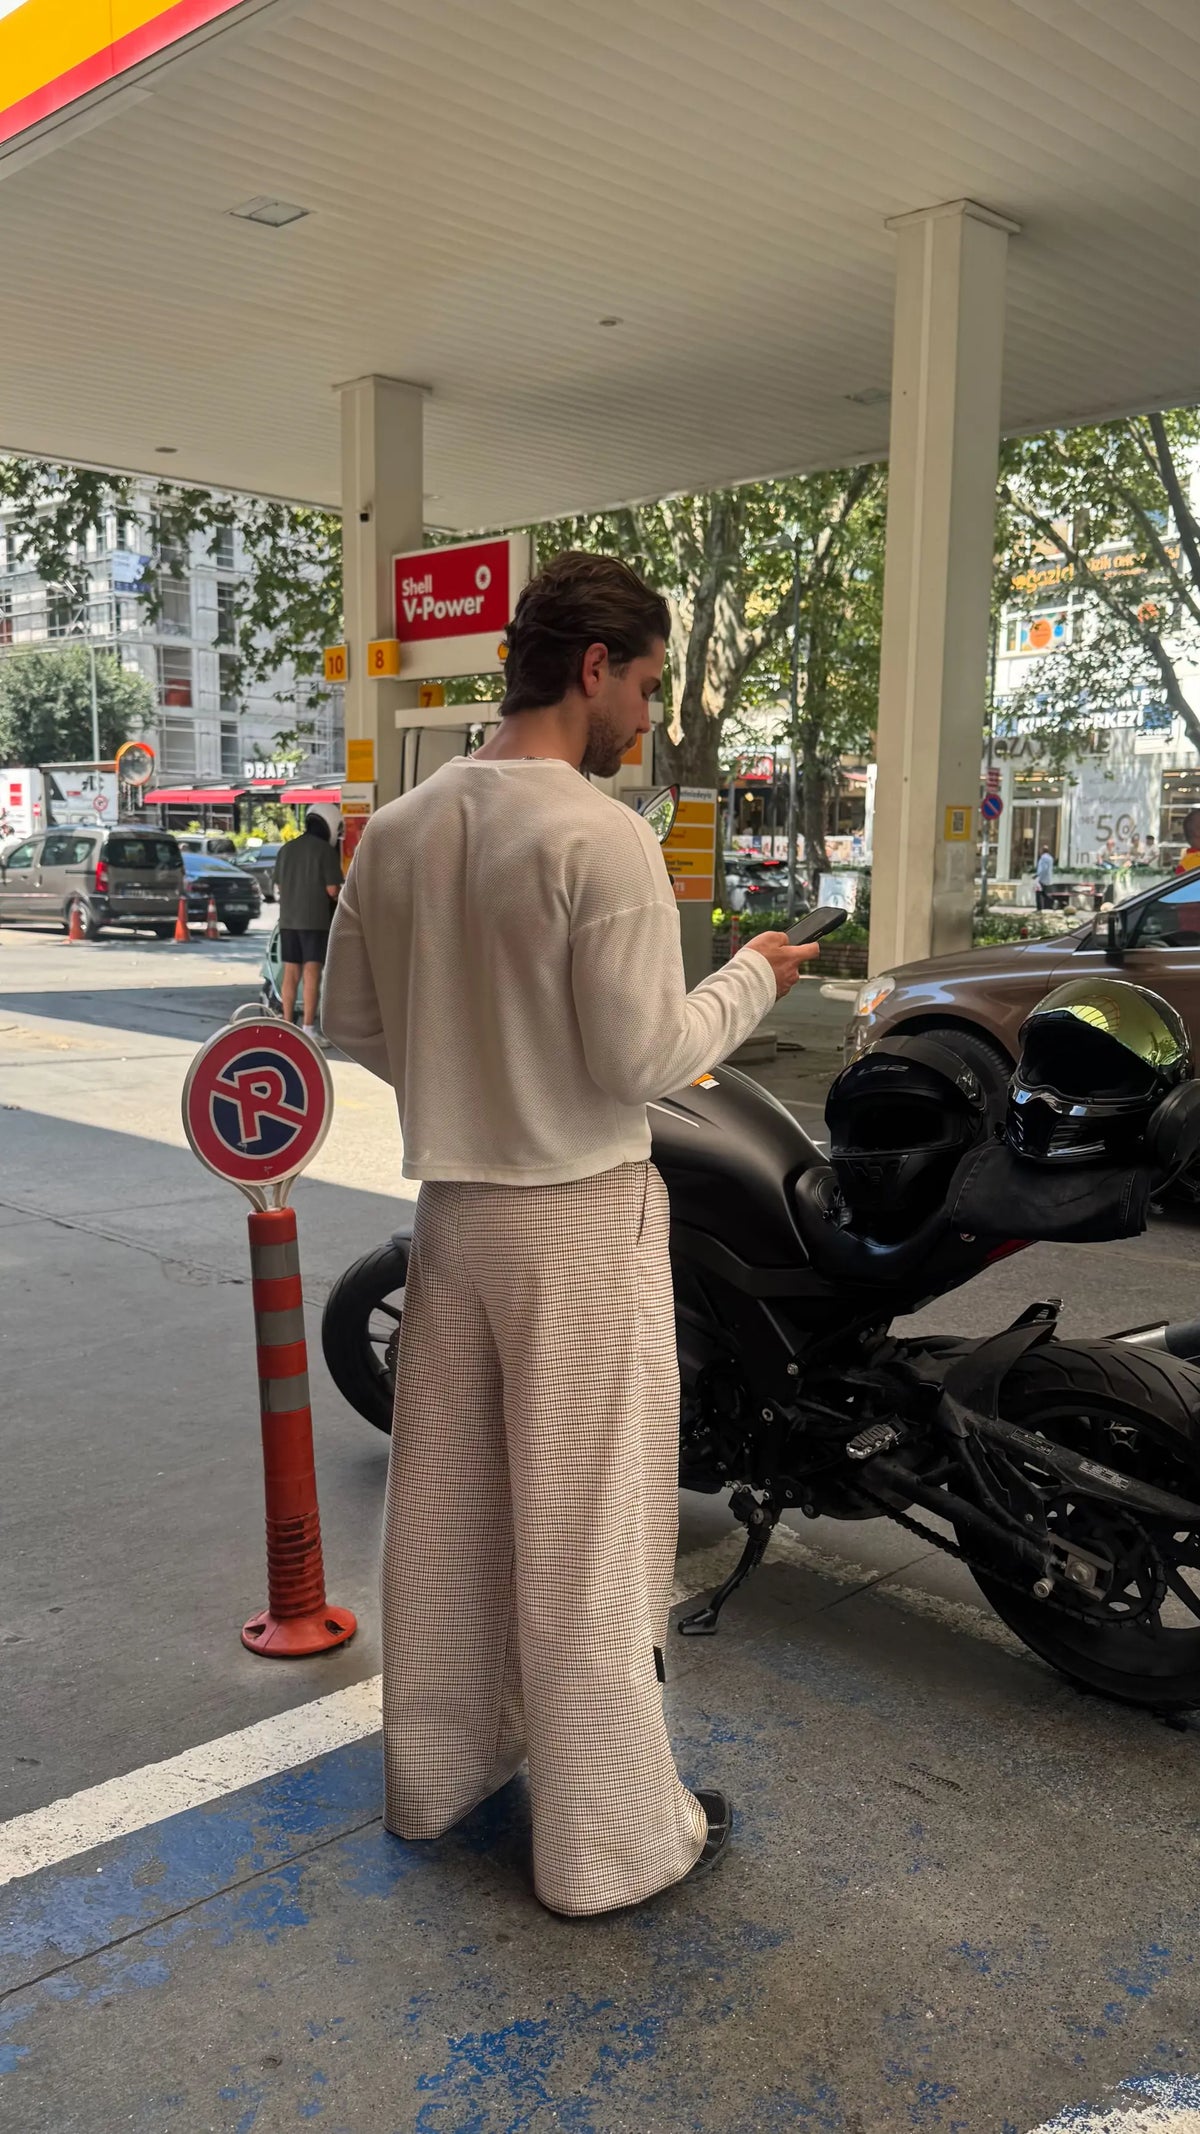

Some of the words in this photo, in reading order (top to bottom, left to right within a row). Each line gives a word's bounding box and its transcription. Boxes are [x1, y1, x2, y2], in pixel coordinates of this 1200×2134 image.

[402, 574, 433, 596] Shell
[402, 595, 485, 623] V-Power
[328, 655, 345, 675] 10
[375, 649, 385, 669] 8
[422, 692, 433, 708] 7
[243, 761, 297, 779] DRAFT
